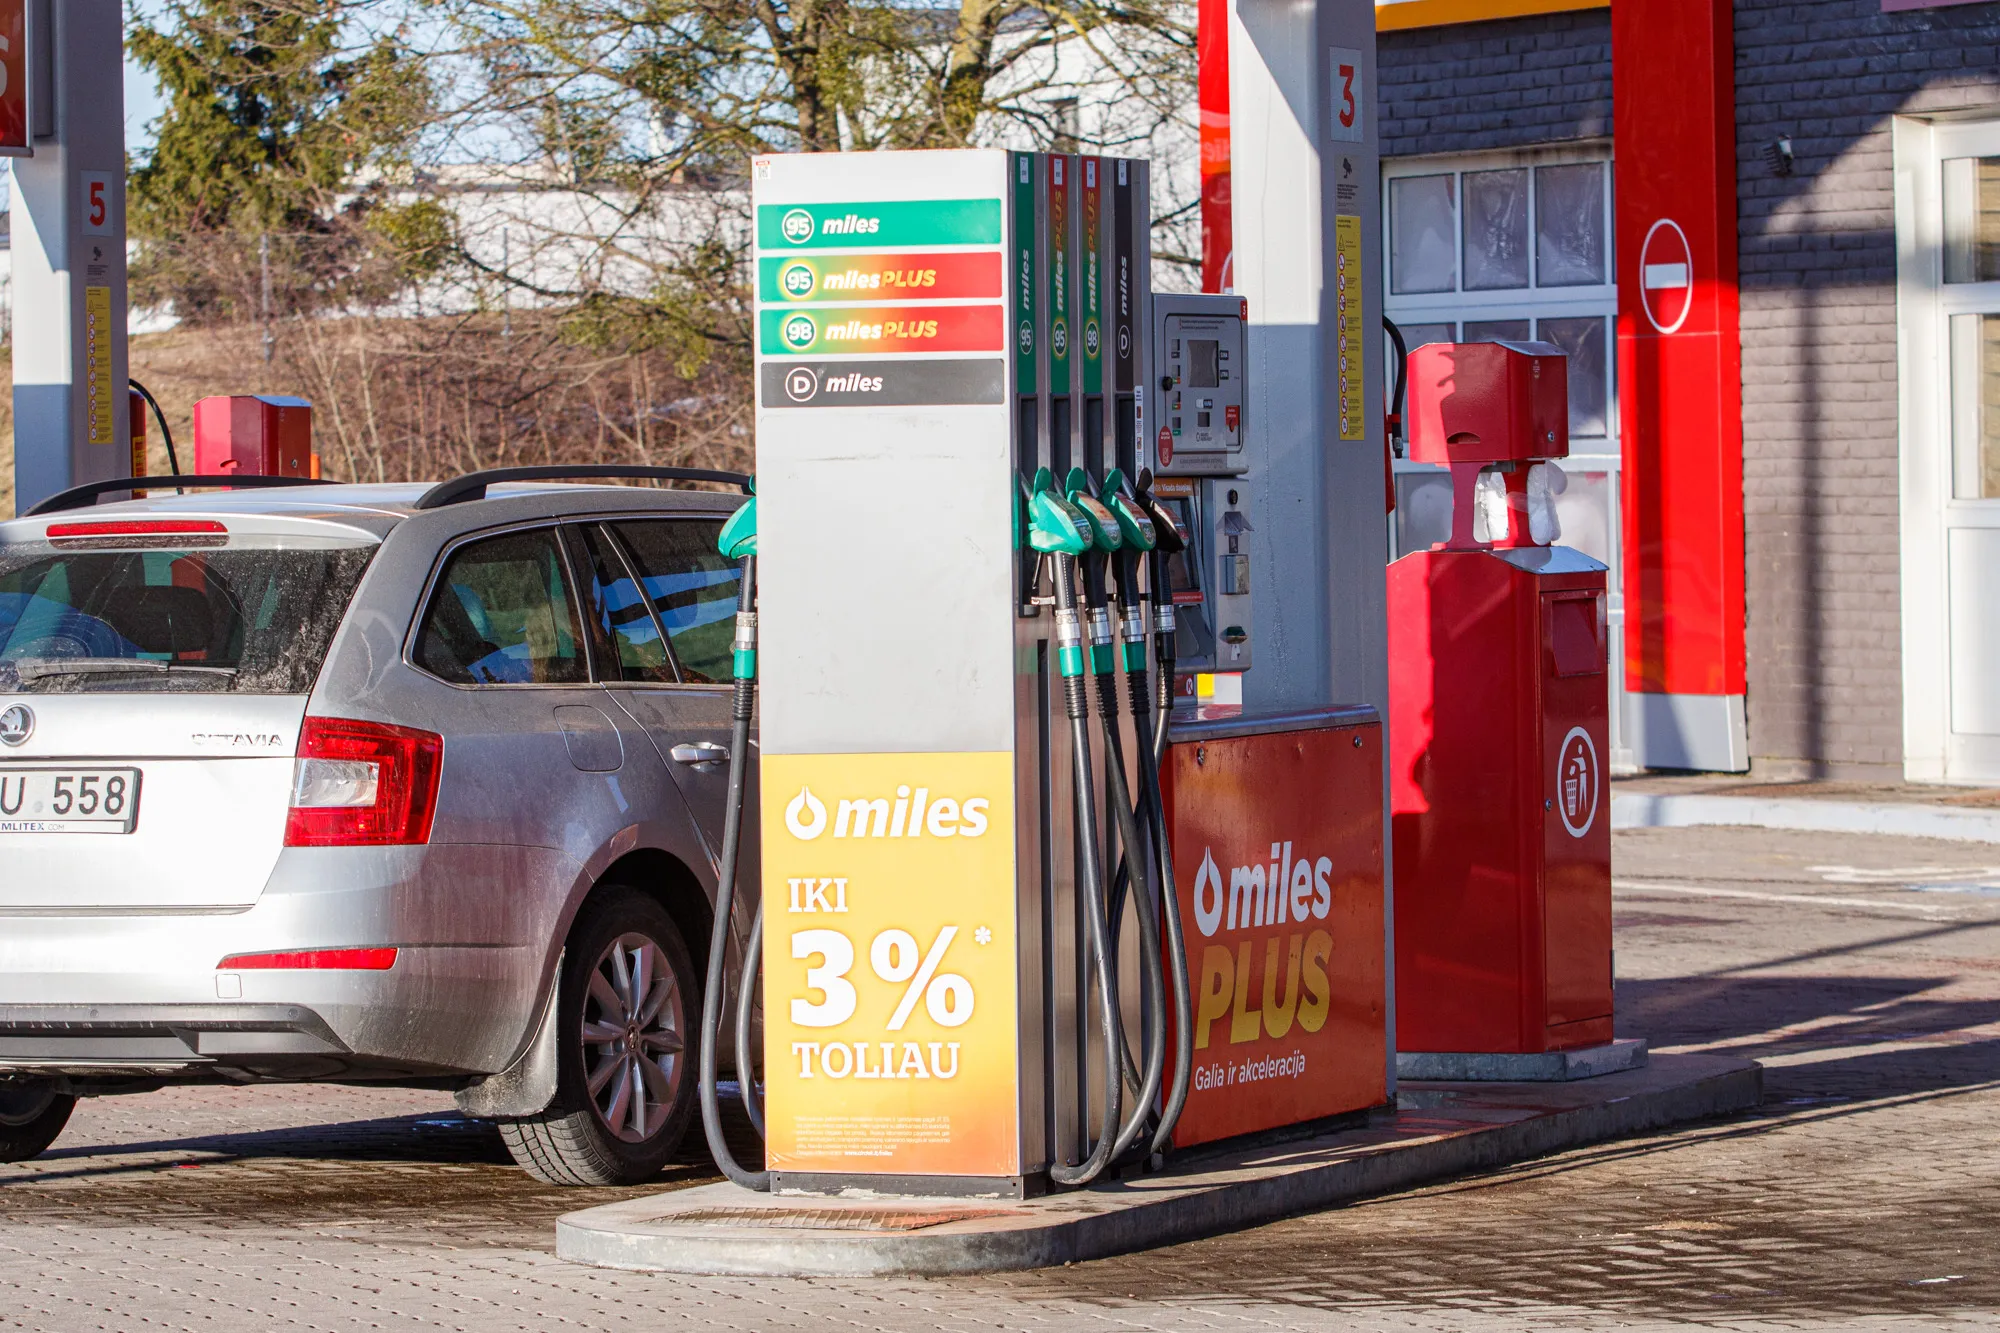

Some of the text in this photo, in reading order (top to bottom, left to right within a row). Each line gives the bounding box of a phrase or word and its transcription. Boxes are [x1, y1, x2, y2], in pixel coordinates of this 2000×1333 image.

[1339, 64, 1355, 128] 3
[89, 181, 106, 227] 5
[785, 214, 880, 236] 95 miles
[786, 271, 812, 290] 95
[1021, 249, 1032, 346] miles 95
[1120, 255, 1128, 350] miles D
[787, 322, 813, 341] 98
[1055, 330, 1065, 347] 95
[1087, 330, 1097, 347] 98
[793, 373, 883, 394] D miles
[53, 776, 126, 815] 558
[834, 785, 990, 838] miles
[787, 878, 848, 912] IKI
[1227, 841, 1333, 931] miles
[1195, 929, 1334, 1050] PLUS
[791, 1042, 961, 1079] TOLIAU
[1195, 1050, 1306, 1091] Galia ir akceleracija
